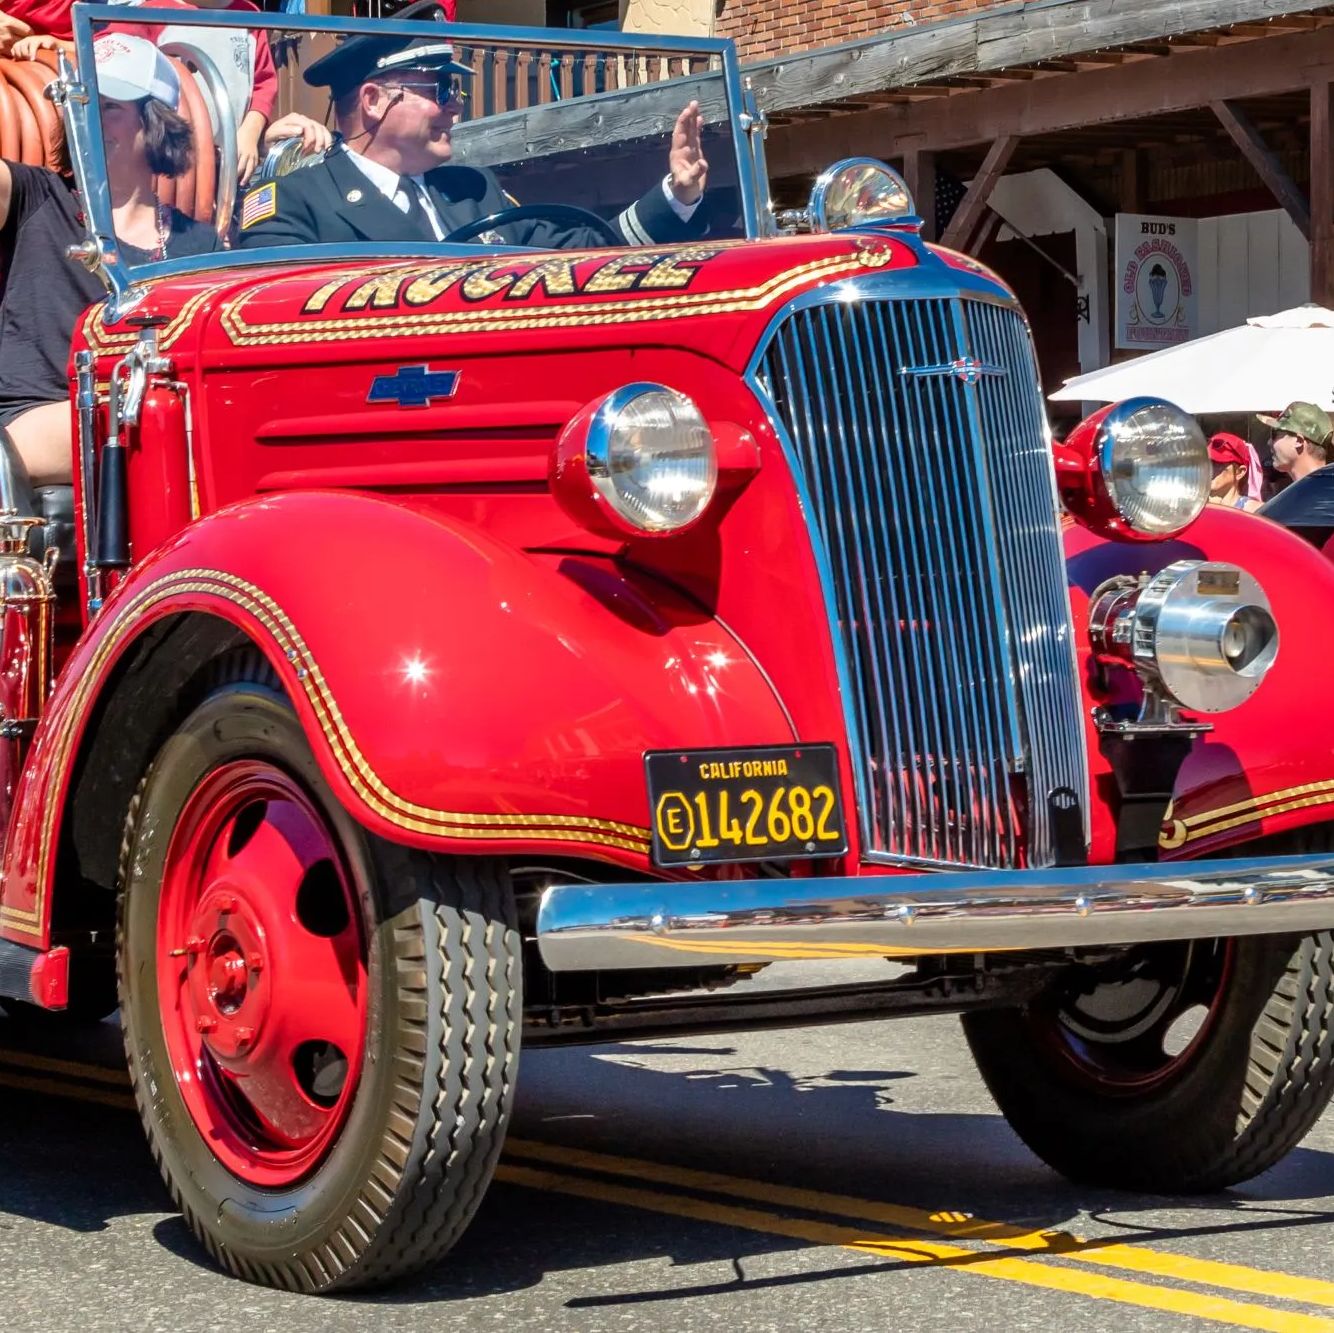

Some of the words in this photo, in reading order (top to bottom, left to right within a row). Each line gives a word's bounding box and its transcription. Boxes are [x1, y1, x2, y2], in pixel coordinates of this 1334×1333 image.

[1141, 221, 1176, 236] BUD'S
[300, 248, 725, 315] TRUCKEE
[698, 758, 789, 780] CALIFORNIA
